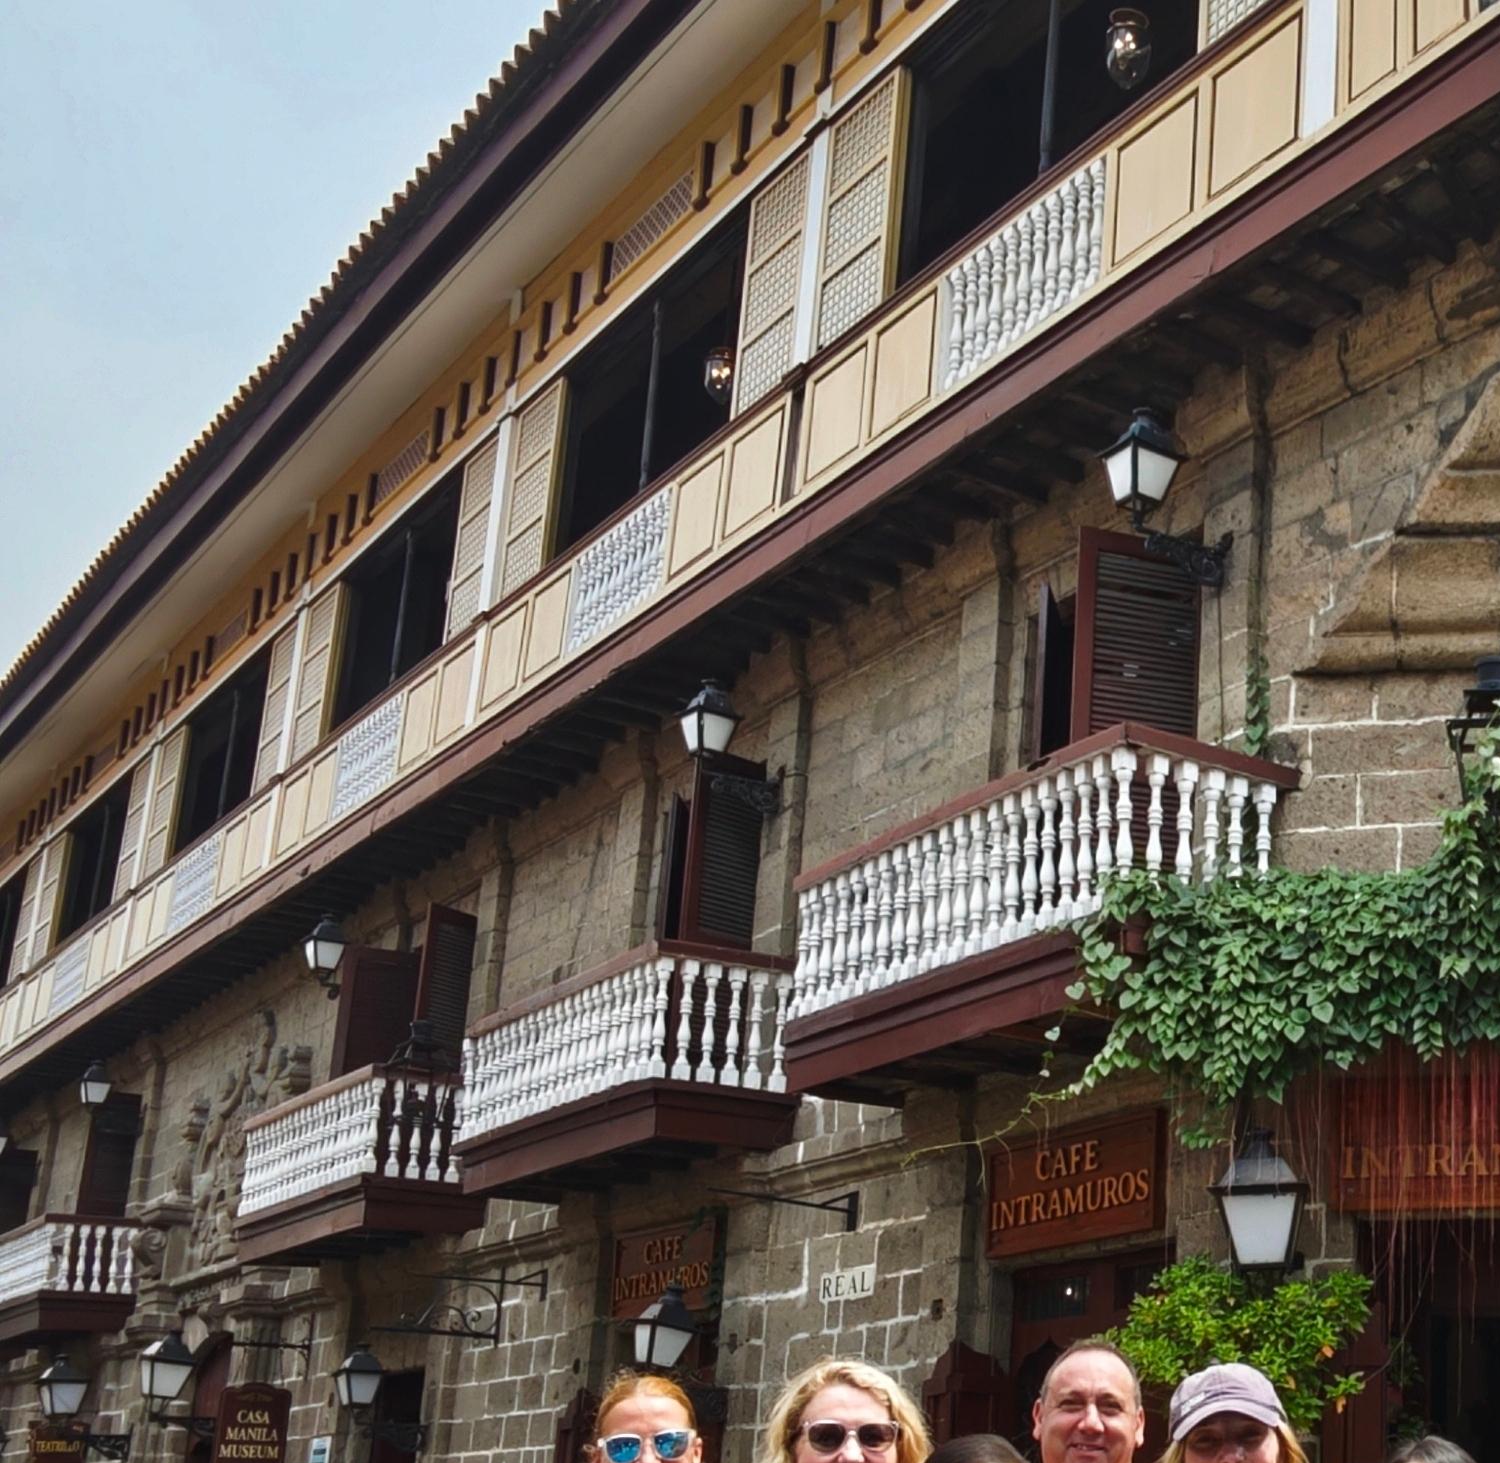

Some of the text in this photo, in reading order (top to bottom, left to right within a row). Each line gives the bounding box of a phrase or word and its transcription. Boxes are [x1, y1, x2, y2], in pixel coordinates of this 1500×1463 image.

[1036, 1139, 1098, 1181] CAFE
[991, 1168, 1149, 1231] INTRAMUROS
[644, 1235, 682, 1264] CAFE
[822, 1271, 871, 1300] REAL
[237, 1410, 269, 1425] CASA
[226, 1427, 278, 1442] MANILA
[219, 1445, 279, 1459] MUSEUM
